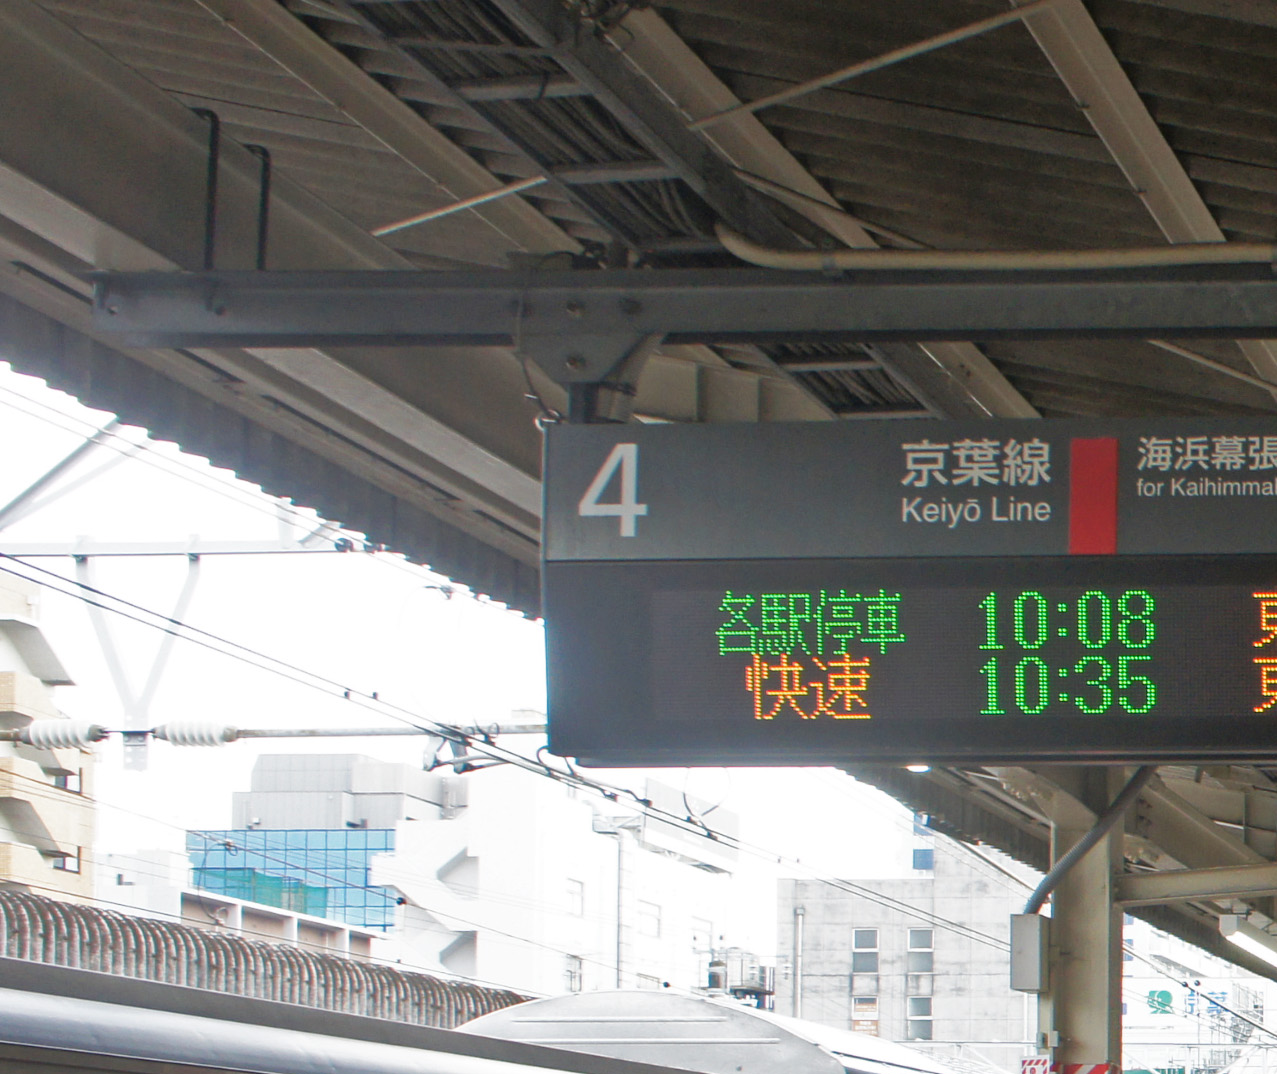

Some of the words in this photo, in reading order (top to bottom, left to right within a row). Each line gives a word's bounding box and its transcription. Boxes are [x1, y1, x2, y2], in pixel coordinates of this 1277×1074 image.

[577, 442, 649, 538] 4
[901, 438, 1052, 489] 京葉線
[1136, 476, 1165, 498] for
[901, 496, 981, 530] Keiyō
[991, 496, 1052, 522] Line
[714, 589, 907, 657] 各駅停車
[977, 589, 1157, 651] 10:08
[745, 653, 872, 721] 快速
[978, 655, 1158, 716] 10:35
